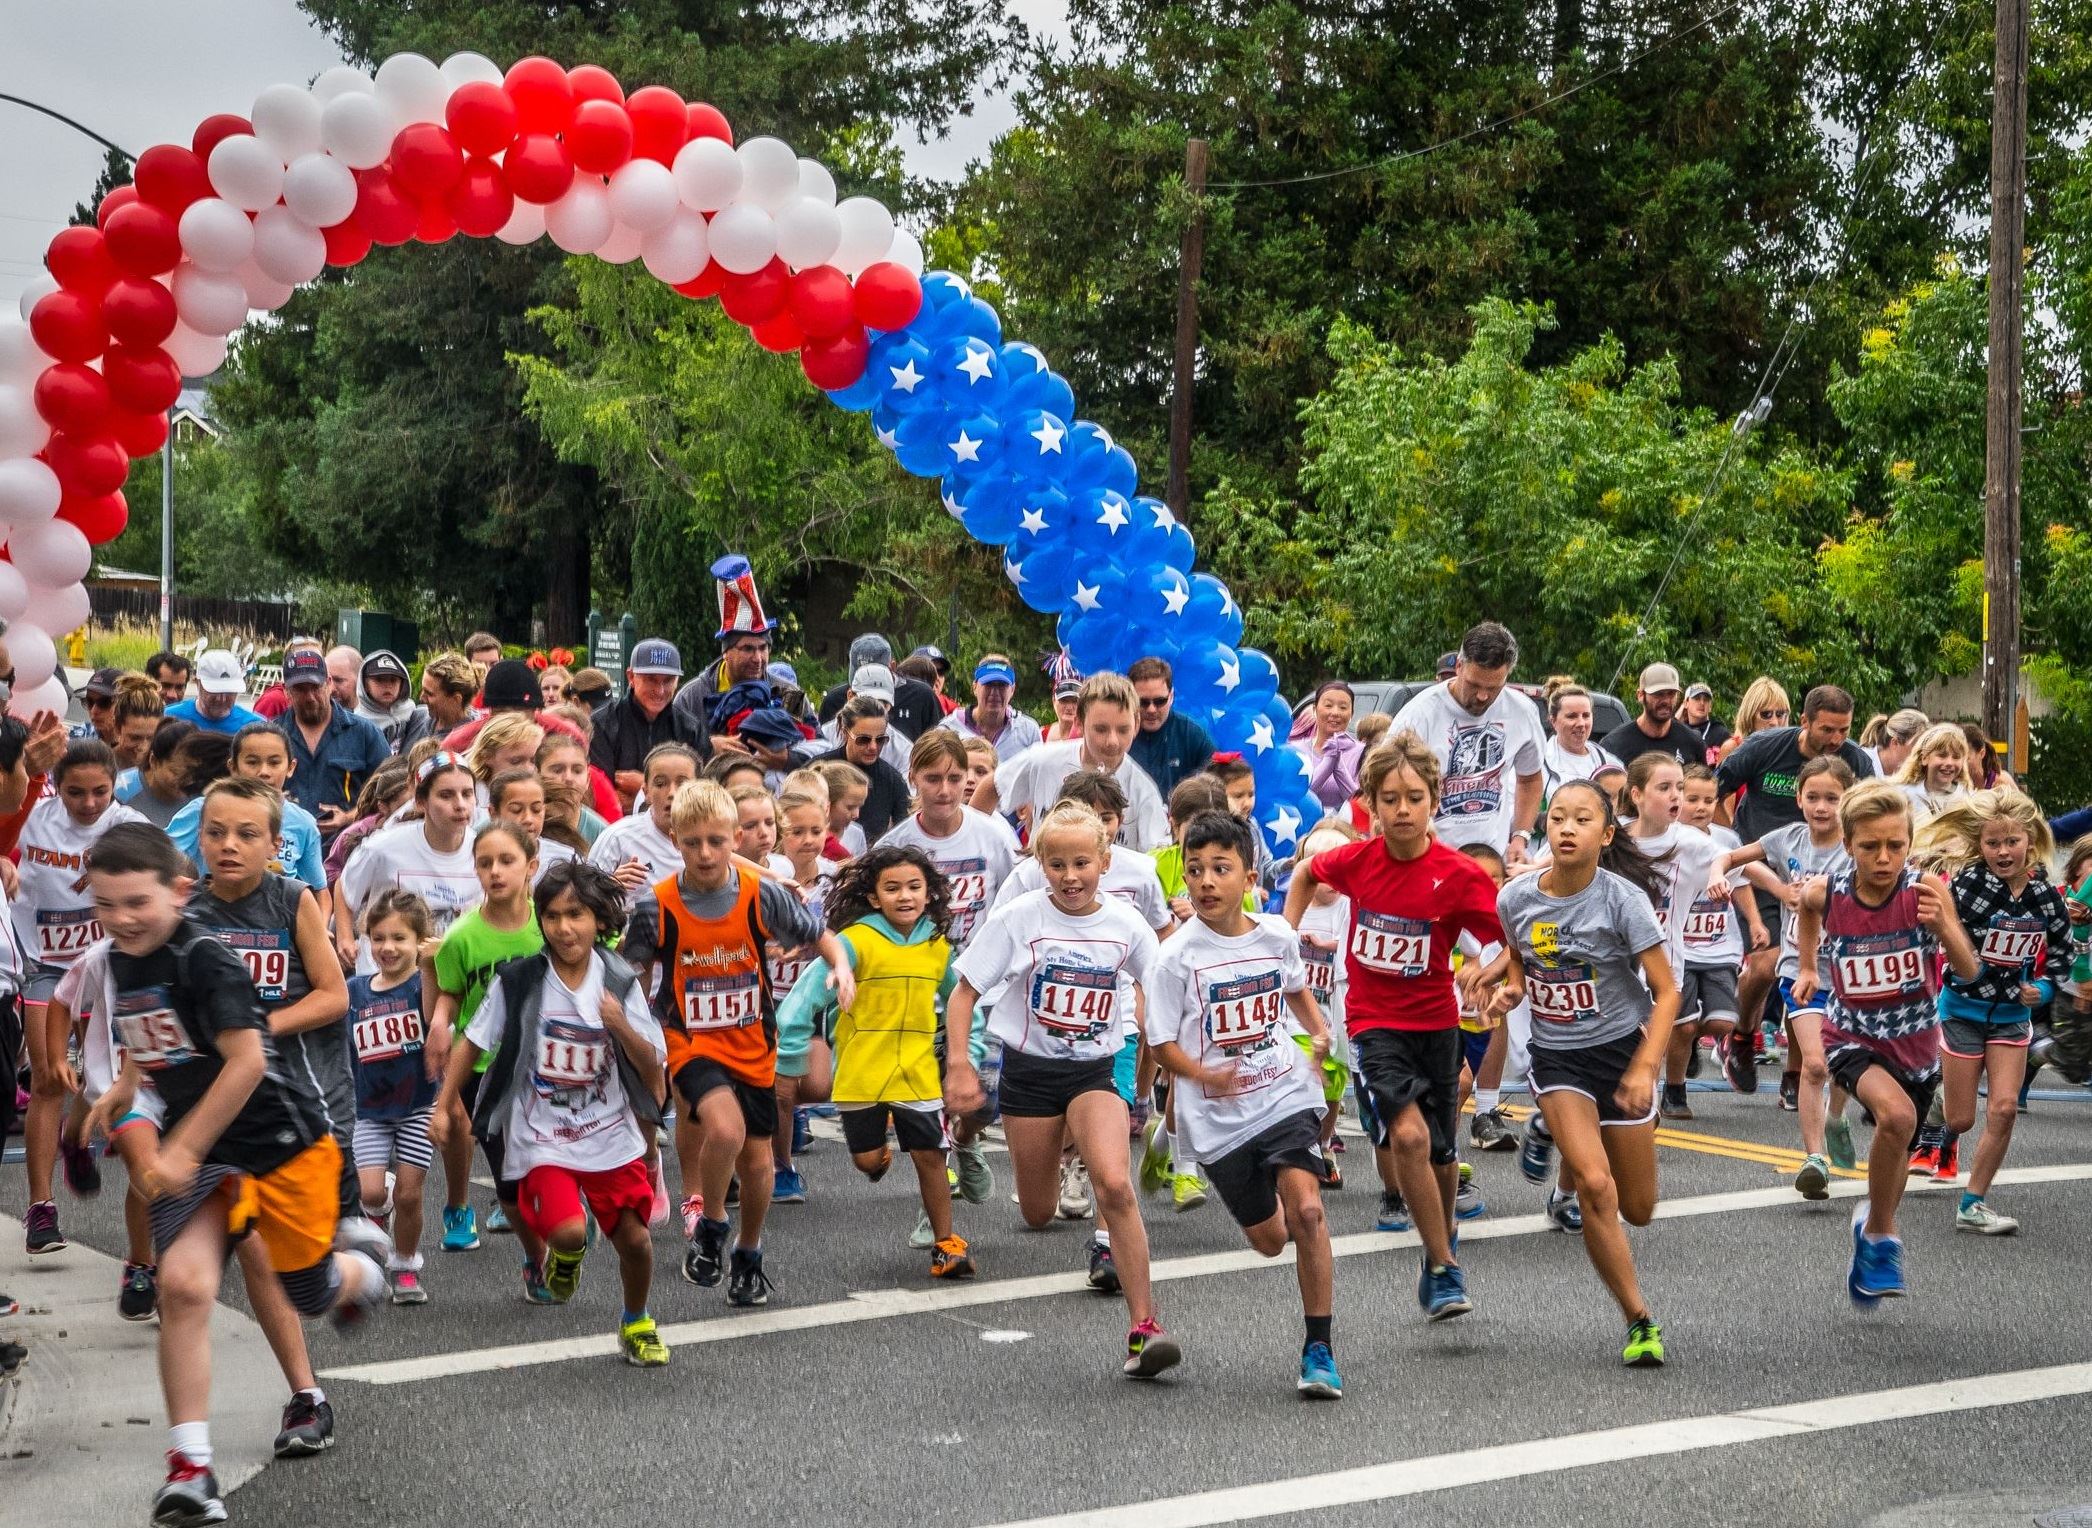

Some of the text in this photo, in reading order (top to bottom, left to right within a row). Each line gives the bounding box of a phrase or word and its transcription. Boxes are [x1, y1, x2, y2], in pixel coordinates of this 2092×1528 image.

[27, 845, 81, 871] TEAM
[952, 875, 985, 901] 23
[41, 920, 105, 951] 1220
[1356, 929, 1424, 965] 1121
[1540, 926, 1576, 938] NOR CAL
[1985, 931, 2042, 957] 1178
[243, 951, 285, 985] 09
[1846, 951, 1920, 987] 1199
[690, 991, 755, 1021] 1151
[1043, 985, 1113, 1021] 1140
[1529, 980, 1594, 1011] 1230
[1216, 991, 1280, 1034] 1149
[357, 1013, 420, 1051] 1186
[543, 1040, 602, 1074] 111
